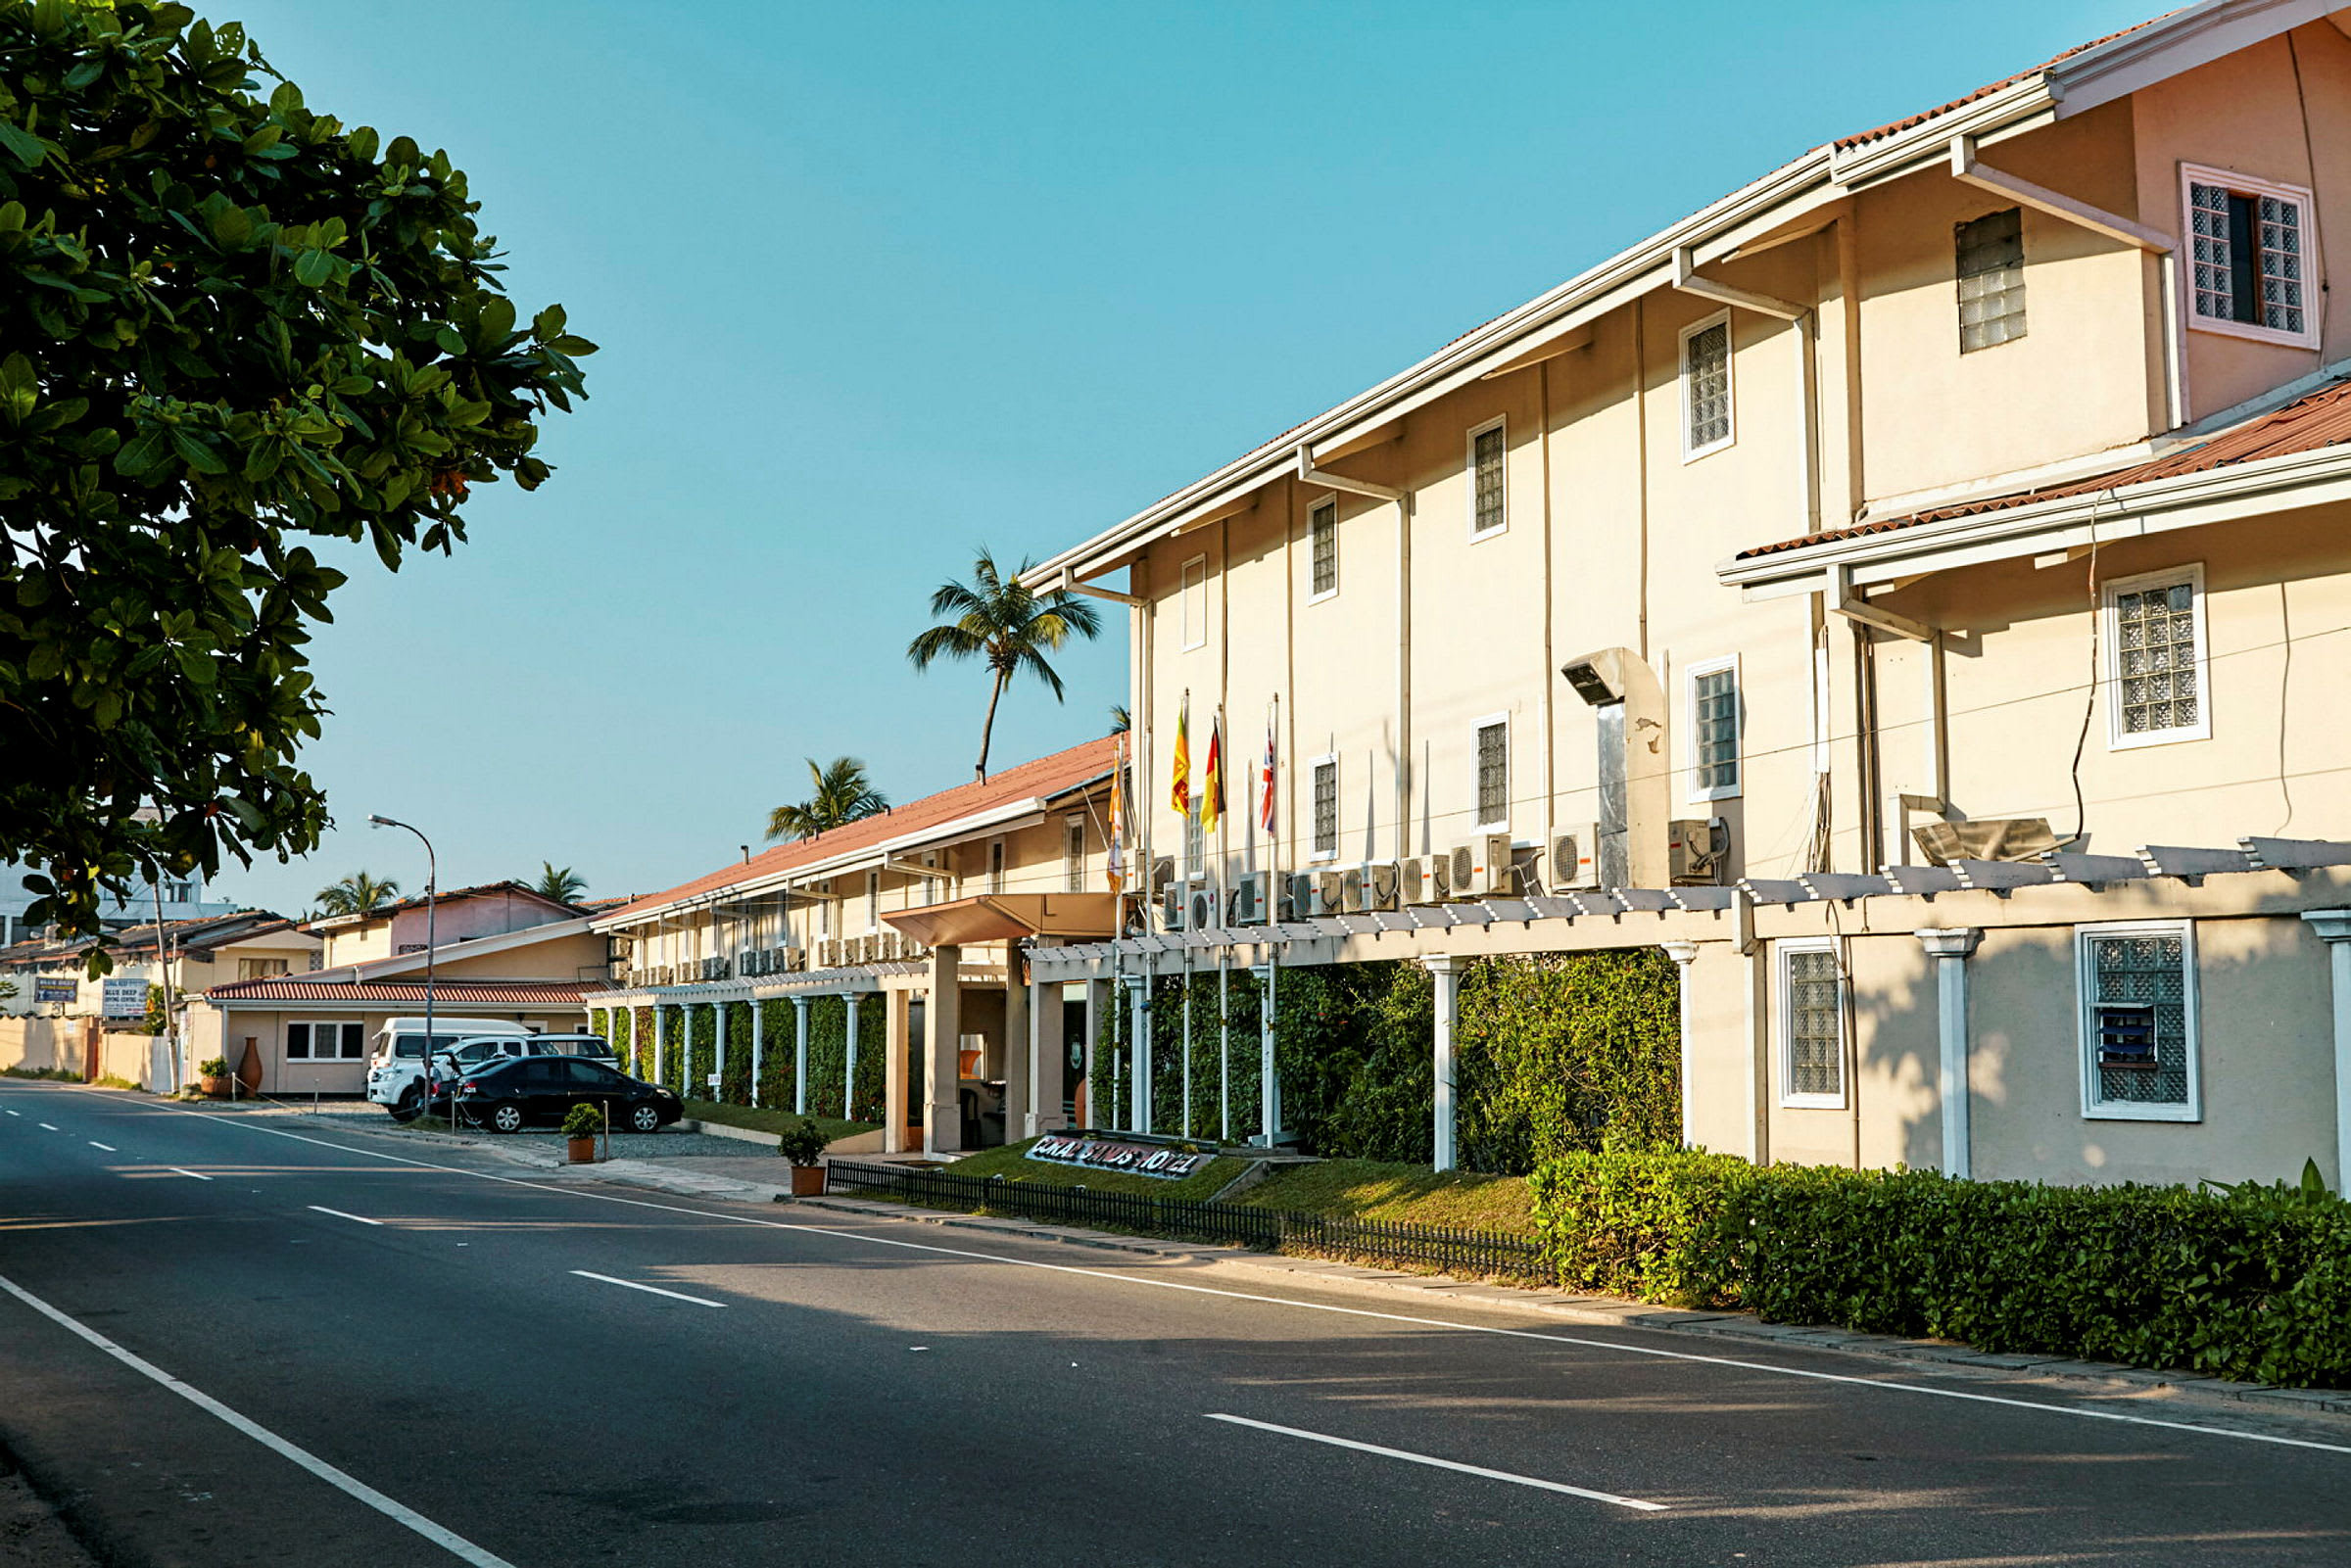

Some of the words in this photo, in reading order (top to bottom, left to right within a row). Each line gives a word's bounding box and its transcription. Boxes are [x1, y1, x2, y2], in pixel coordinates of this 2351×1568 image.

[1032, 1136, 1081, 1159] CORAL
[1082, 1142, 1133, 1164] SANDS
[1134, 1150, 1198, 1173] HOTEL
